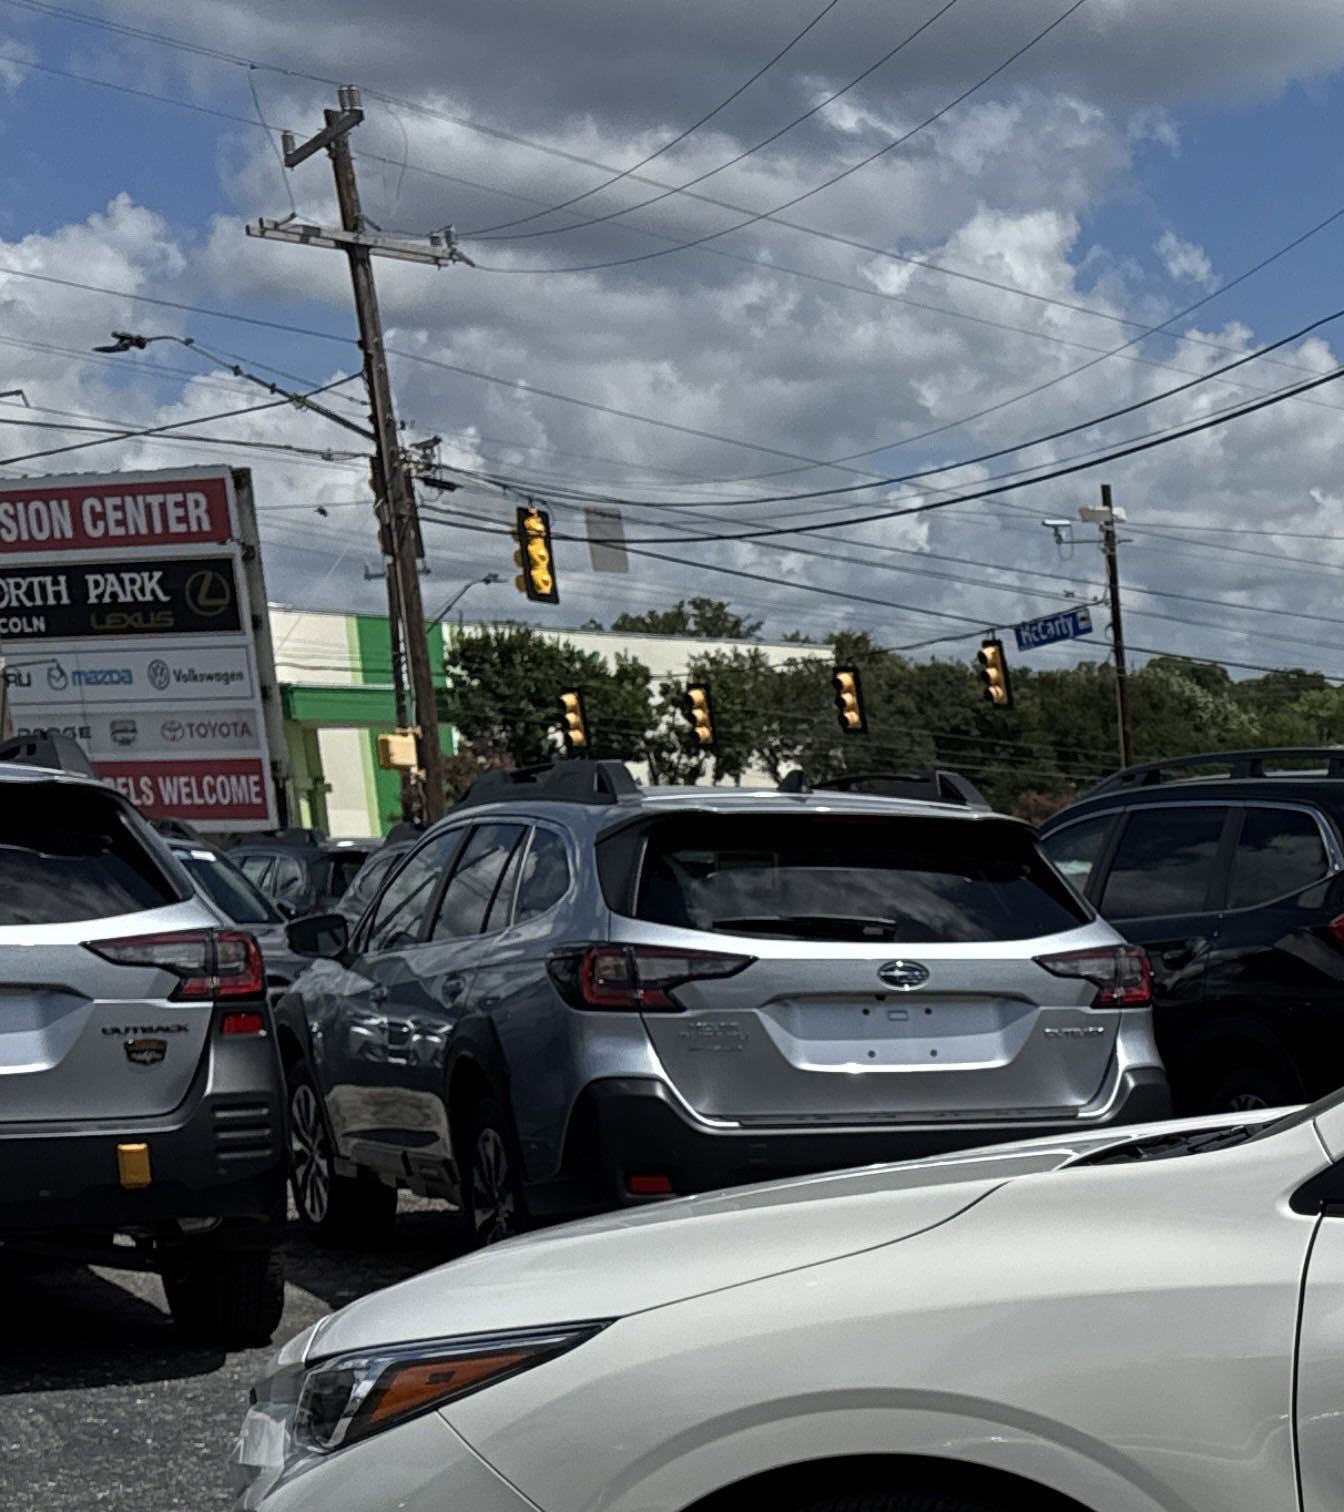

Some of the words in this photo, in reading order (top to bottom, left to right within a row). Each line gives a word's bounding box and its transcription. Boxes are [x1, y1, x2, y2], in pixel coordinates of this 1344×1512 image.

[82, 491, 213, 539] CENTER
[85, 571, 171, 605] PARK
[91, 611, 174, 630] LEXUS
[172, 669, 244, 685] Volkswagen
[188, 722, 251, 738] TOYOTA
[157, 775, 262, 806] WELCOME
